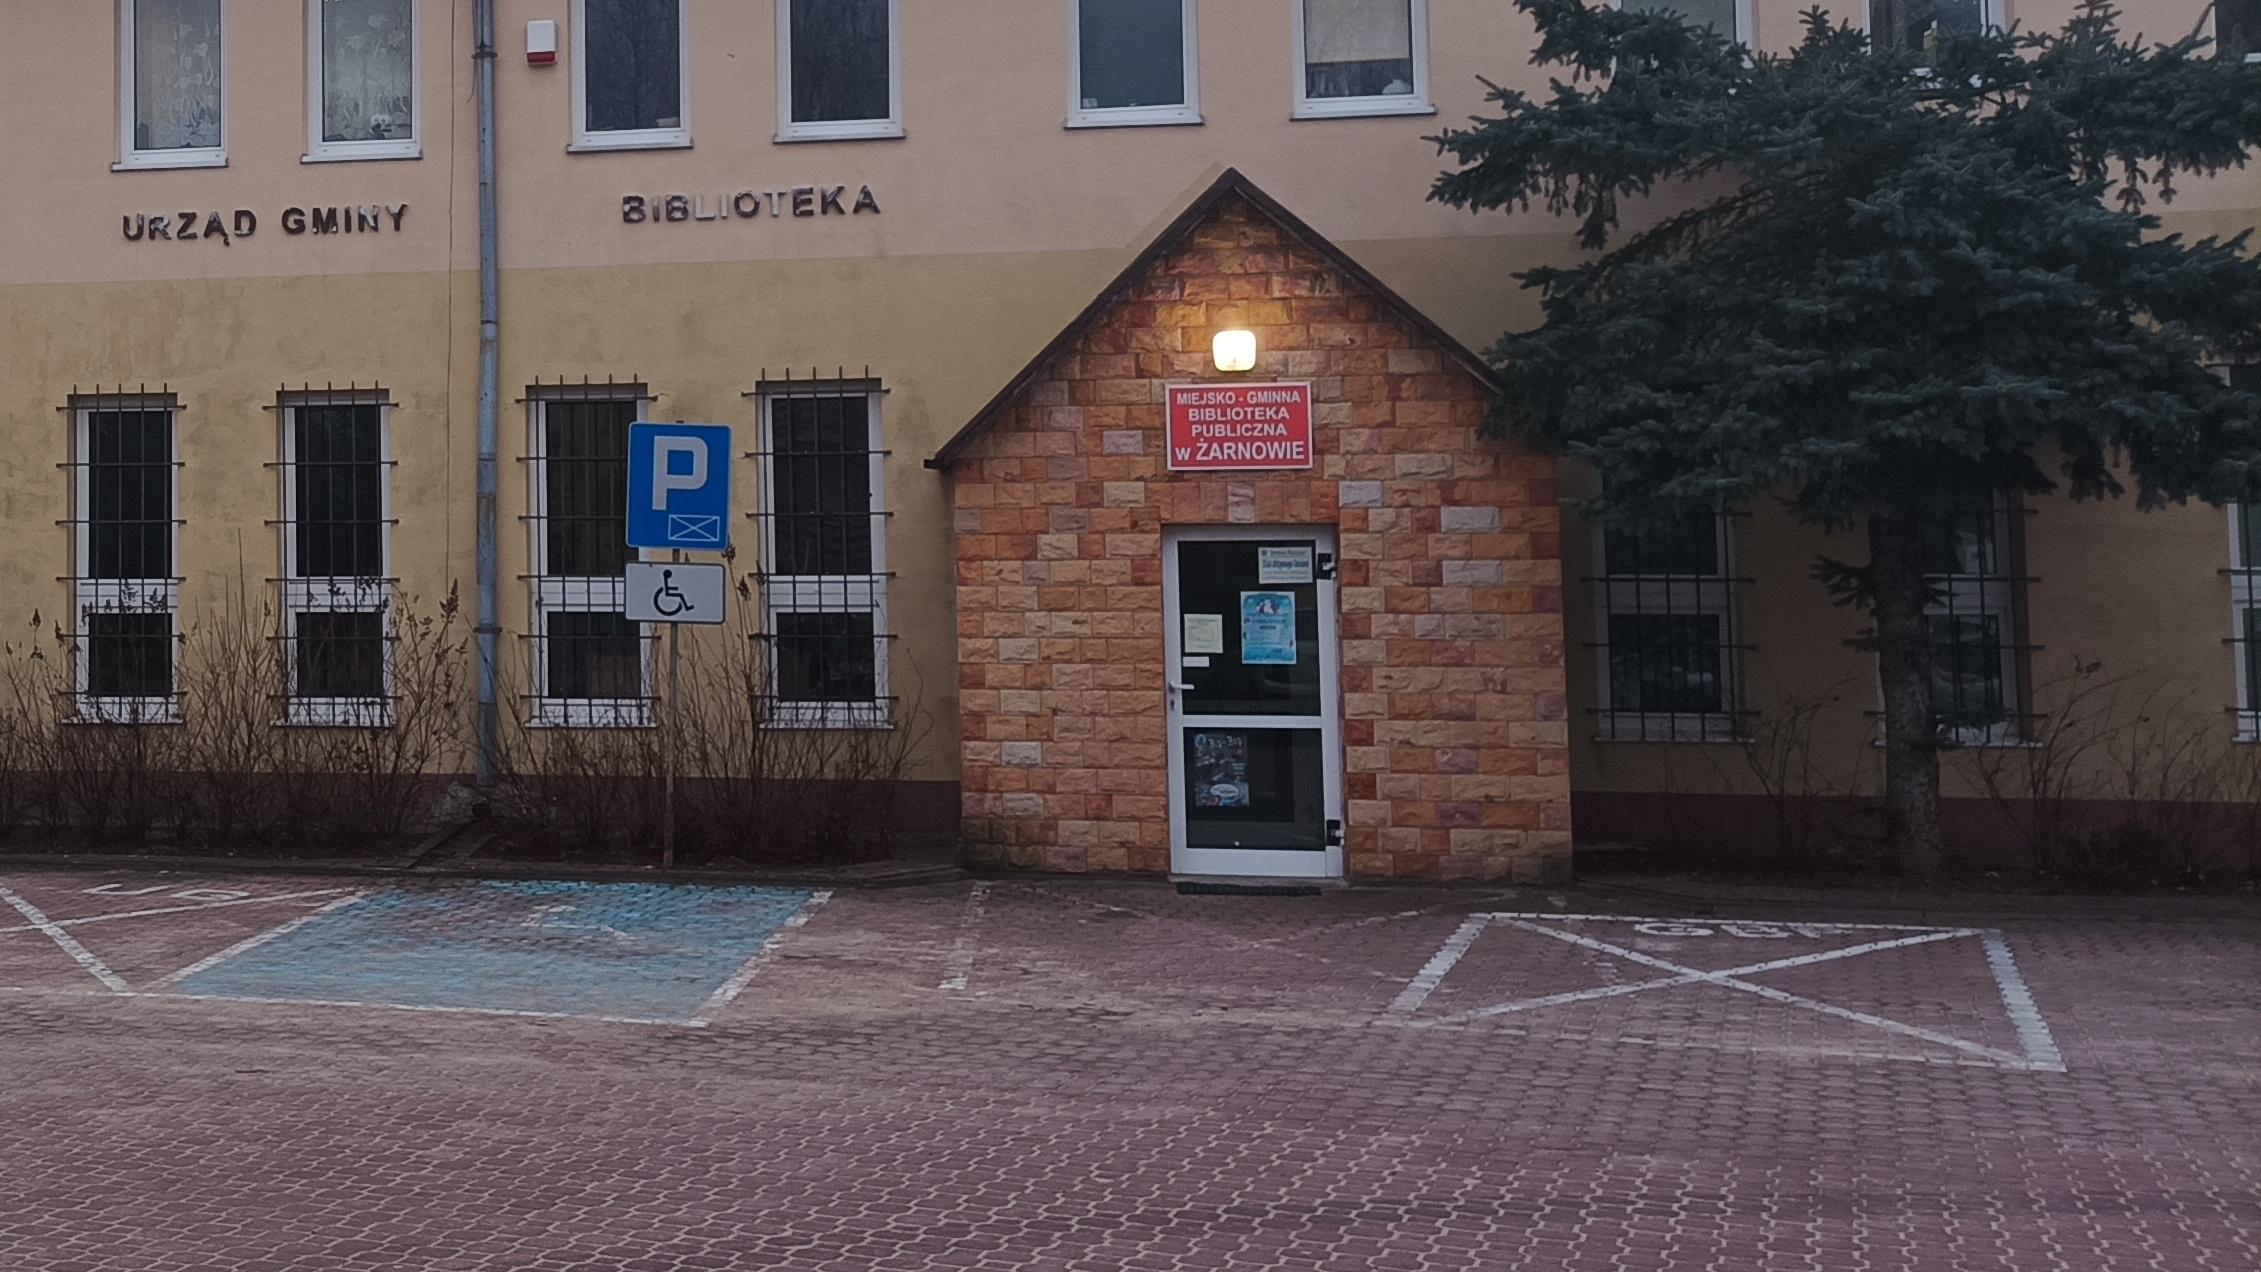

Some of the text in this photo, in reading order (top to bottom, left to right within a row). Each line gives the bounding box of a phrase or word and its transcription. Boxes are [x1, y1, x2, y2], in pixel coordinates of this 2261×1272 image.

[622, 185, 881, 223] BIBLIOTEKA
[123, 203, 409, 247] URZĄD GMINY
[1176, 391, 1236, 406] MIEJSKO
[1246, 390, 1301, 405] GMINNA
[1188, 406, 1290, 422] BIBLIOTEKA
[1191, 423, 1288, 438] PUBLICZNA
[1196, 438, 1305, 462] ŻARNOWIE
[652, 435, 708, 511] P
